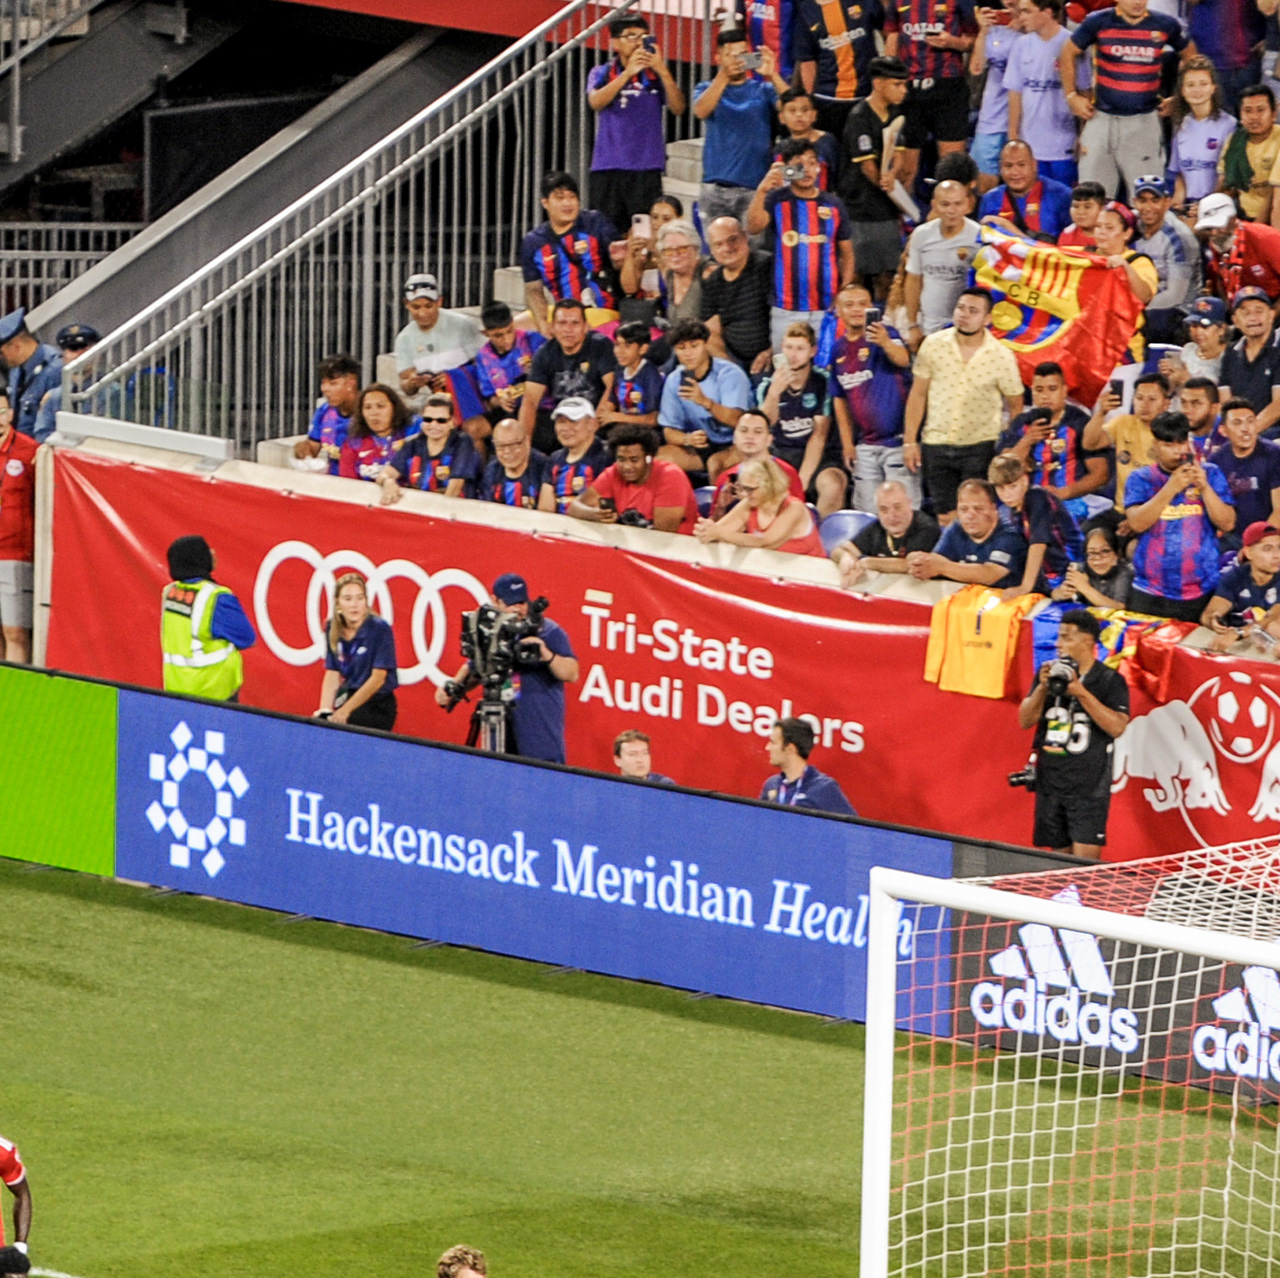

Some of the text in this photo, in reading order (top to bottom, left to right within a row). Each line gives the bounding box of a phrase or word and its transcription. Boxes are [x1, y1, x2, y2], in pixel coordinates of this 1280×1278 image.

[1111, 45, 1155, 57] QATAR
[581, 605, 774, 679] Tri-State
[579, 664, 683, 720] Audi
[285, 788, 914, 955] Hackensack Meridian Healh
[970, 978, 1139, 1053] adidas
